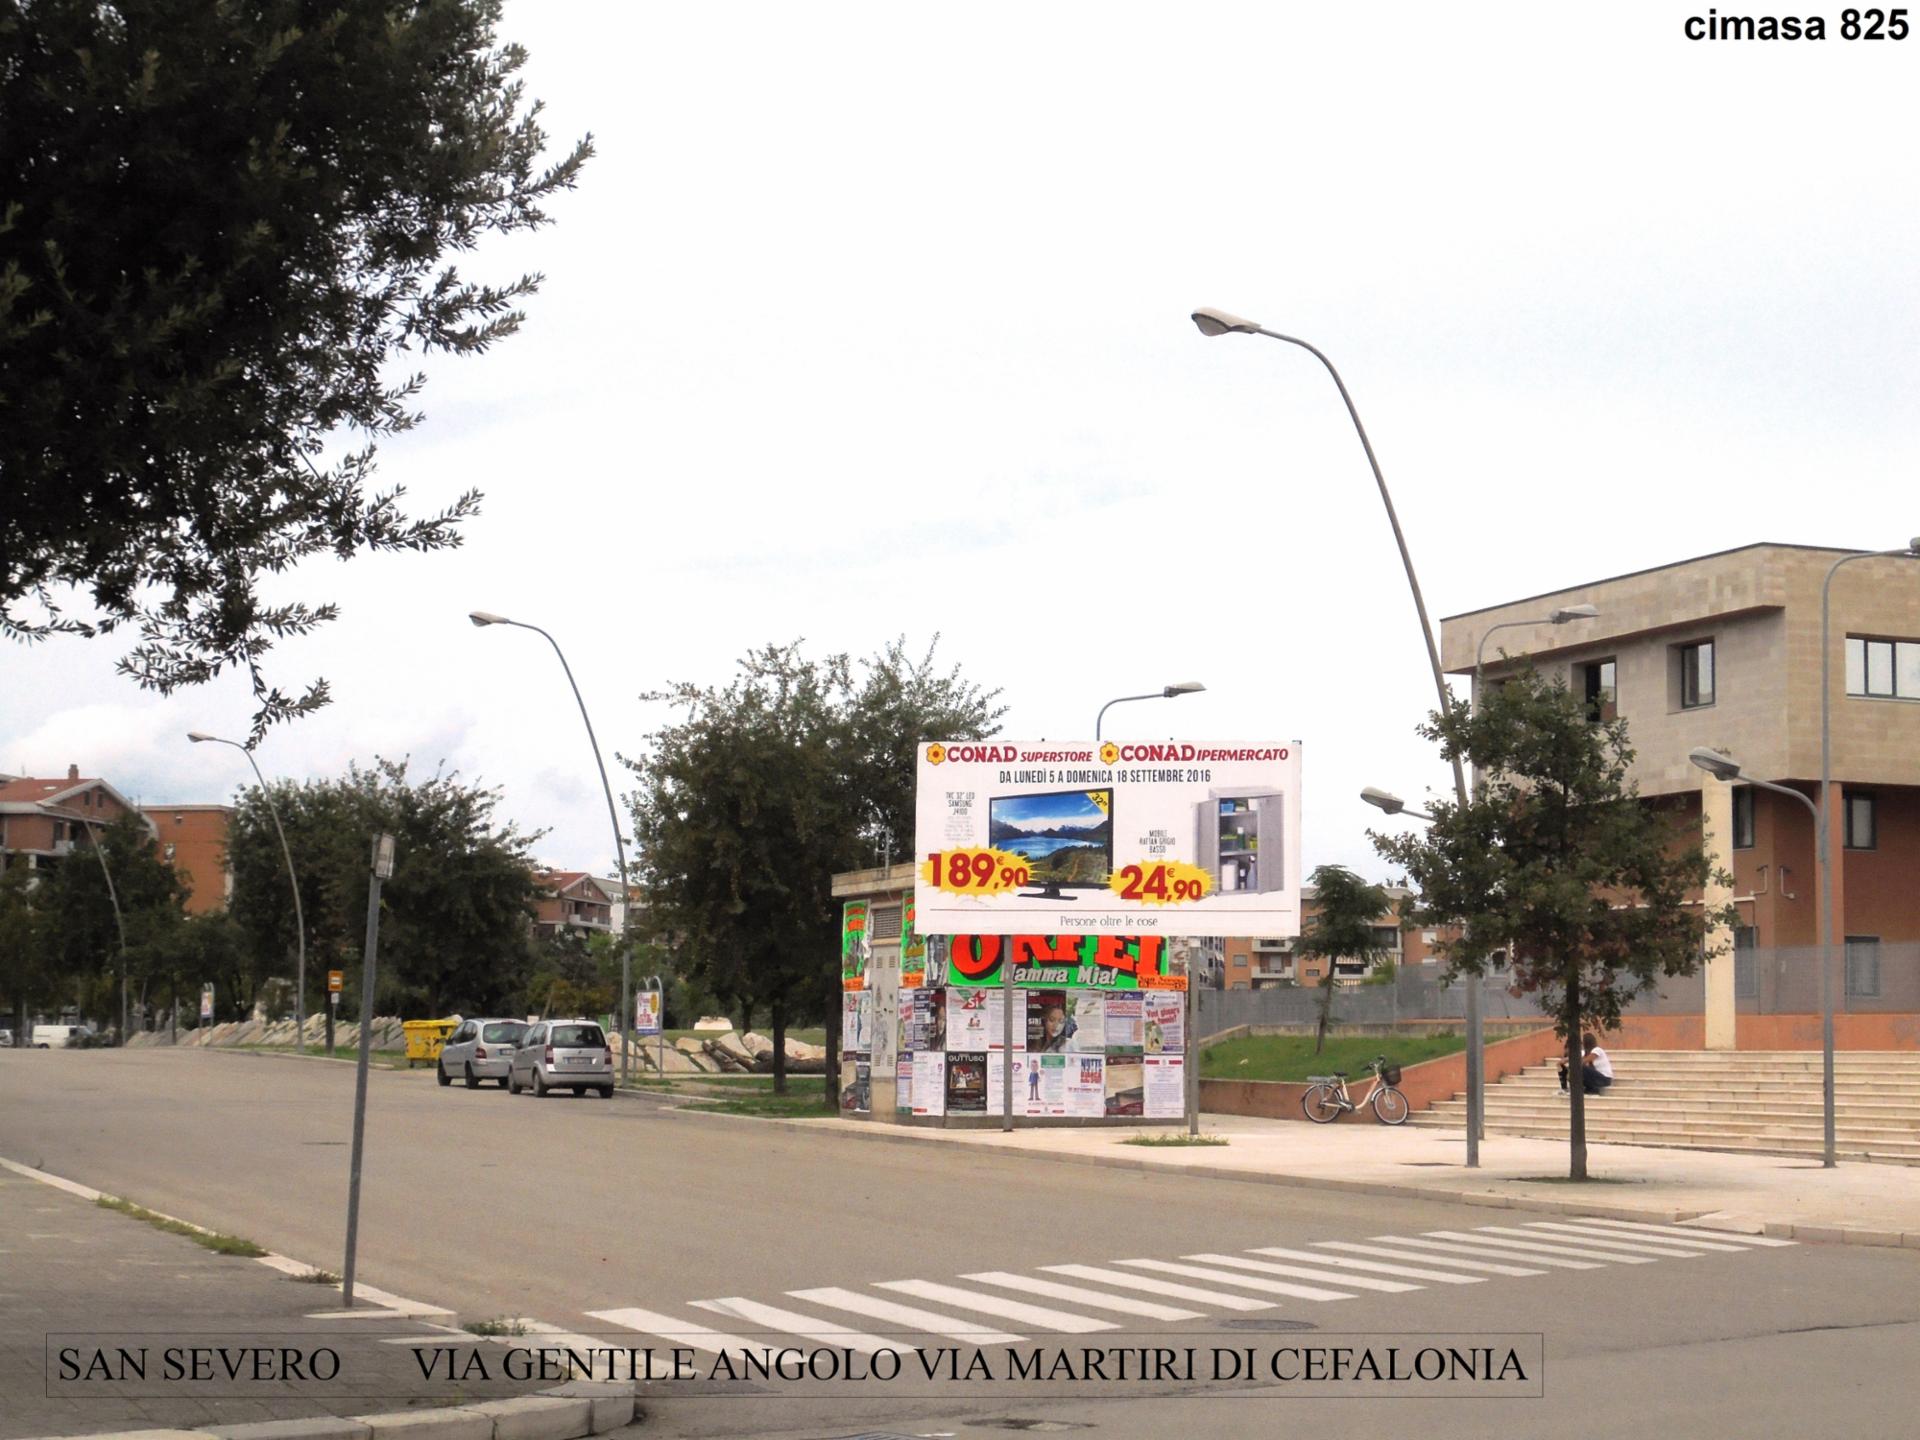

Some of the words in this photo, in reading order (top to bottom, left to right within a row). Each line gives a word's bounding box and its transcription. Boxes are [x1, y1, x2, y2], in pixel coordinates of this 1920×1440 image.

[946, 746, 1018, 763] CONAD
[1020, 751, 1093, 763] SUPERSTORE
[1120, 744, 1196, 762] CONAD
[1196, 748, 1289, 762] IPERMERCATO
[999, 770, 1012, 784] DA
[1014, 768, 1047, 784] LUNEDÌ
[1049, 770, 1055, 784] 5
[1057, 770, 1064, 784] A
[1066, 769, 1114, 784] DOMENICA
[1117, 769, 1128, 783] 18
[1130, 769, 1184, 783] SETTEMBRE
[1187, 769, 1211, 783] 2016
[1059, 914, 1098, 927] Persone
[1099, 914, 1122, 927] oltre
[1125, 914, 1134, 927] le
[1136, 916, 1159, 927] cose
[1076, 965, 1119, 986] Mia!
